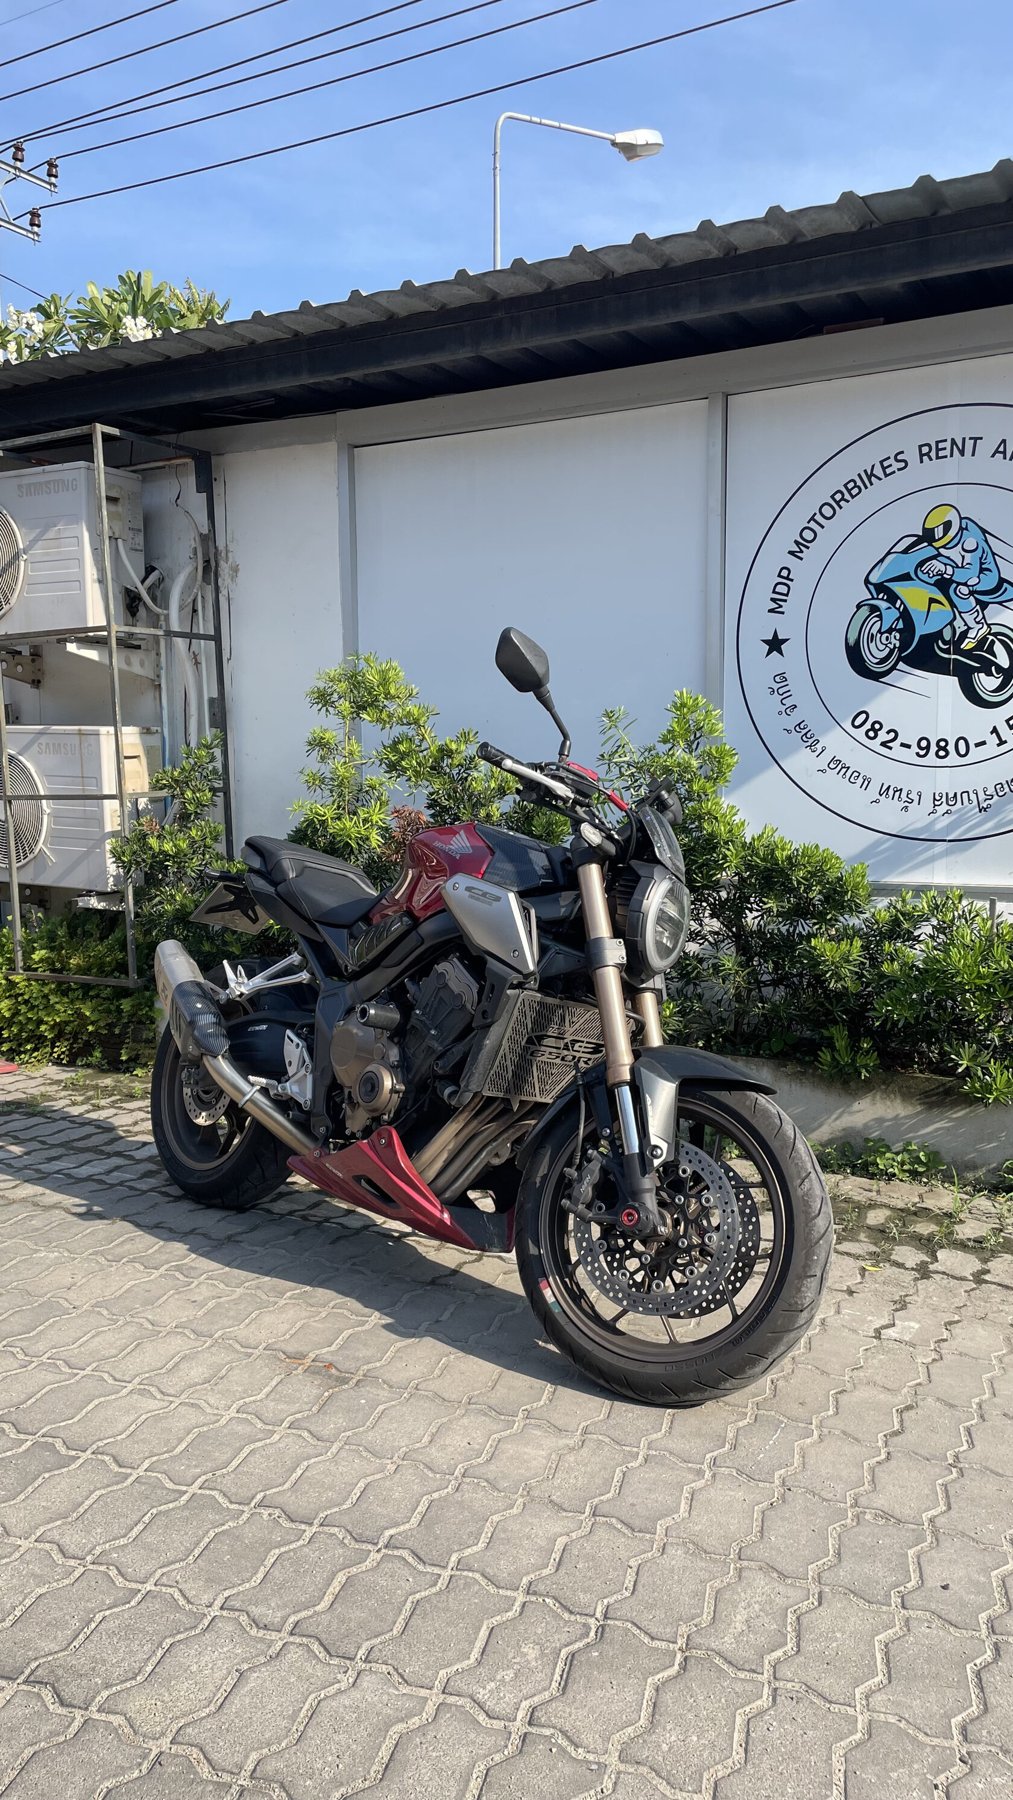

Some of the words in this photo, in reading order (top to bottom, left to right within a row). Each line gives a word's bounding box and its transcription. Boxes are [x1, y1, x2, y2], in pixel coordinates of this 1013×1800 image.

[17, 478, 78, 498] SAMSUNG
[767, 566, 794, 615] MDP
[787, 451, 908, 561] MOTORBIKES
[918, 437, 983, 464] RENT
[990, 439, 1013, 461] A
[768, 672, 797, 716] จำกัด
[817, 756, 872, 791] แอนด์
[434, 840, 460, 860] HONDA
[530, 1048, 592, 1066] 650R
